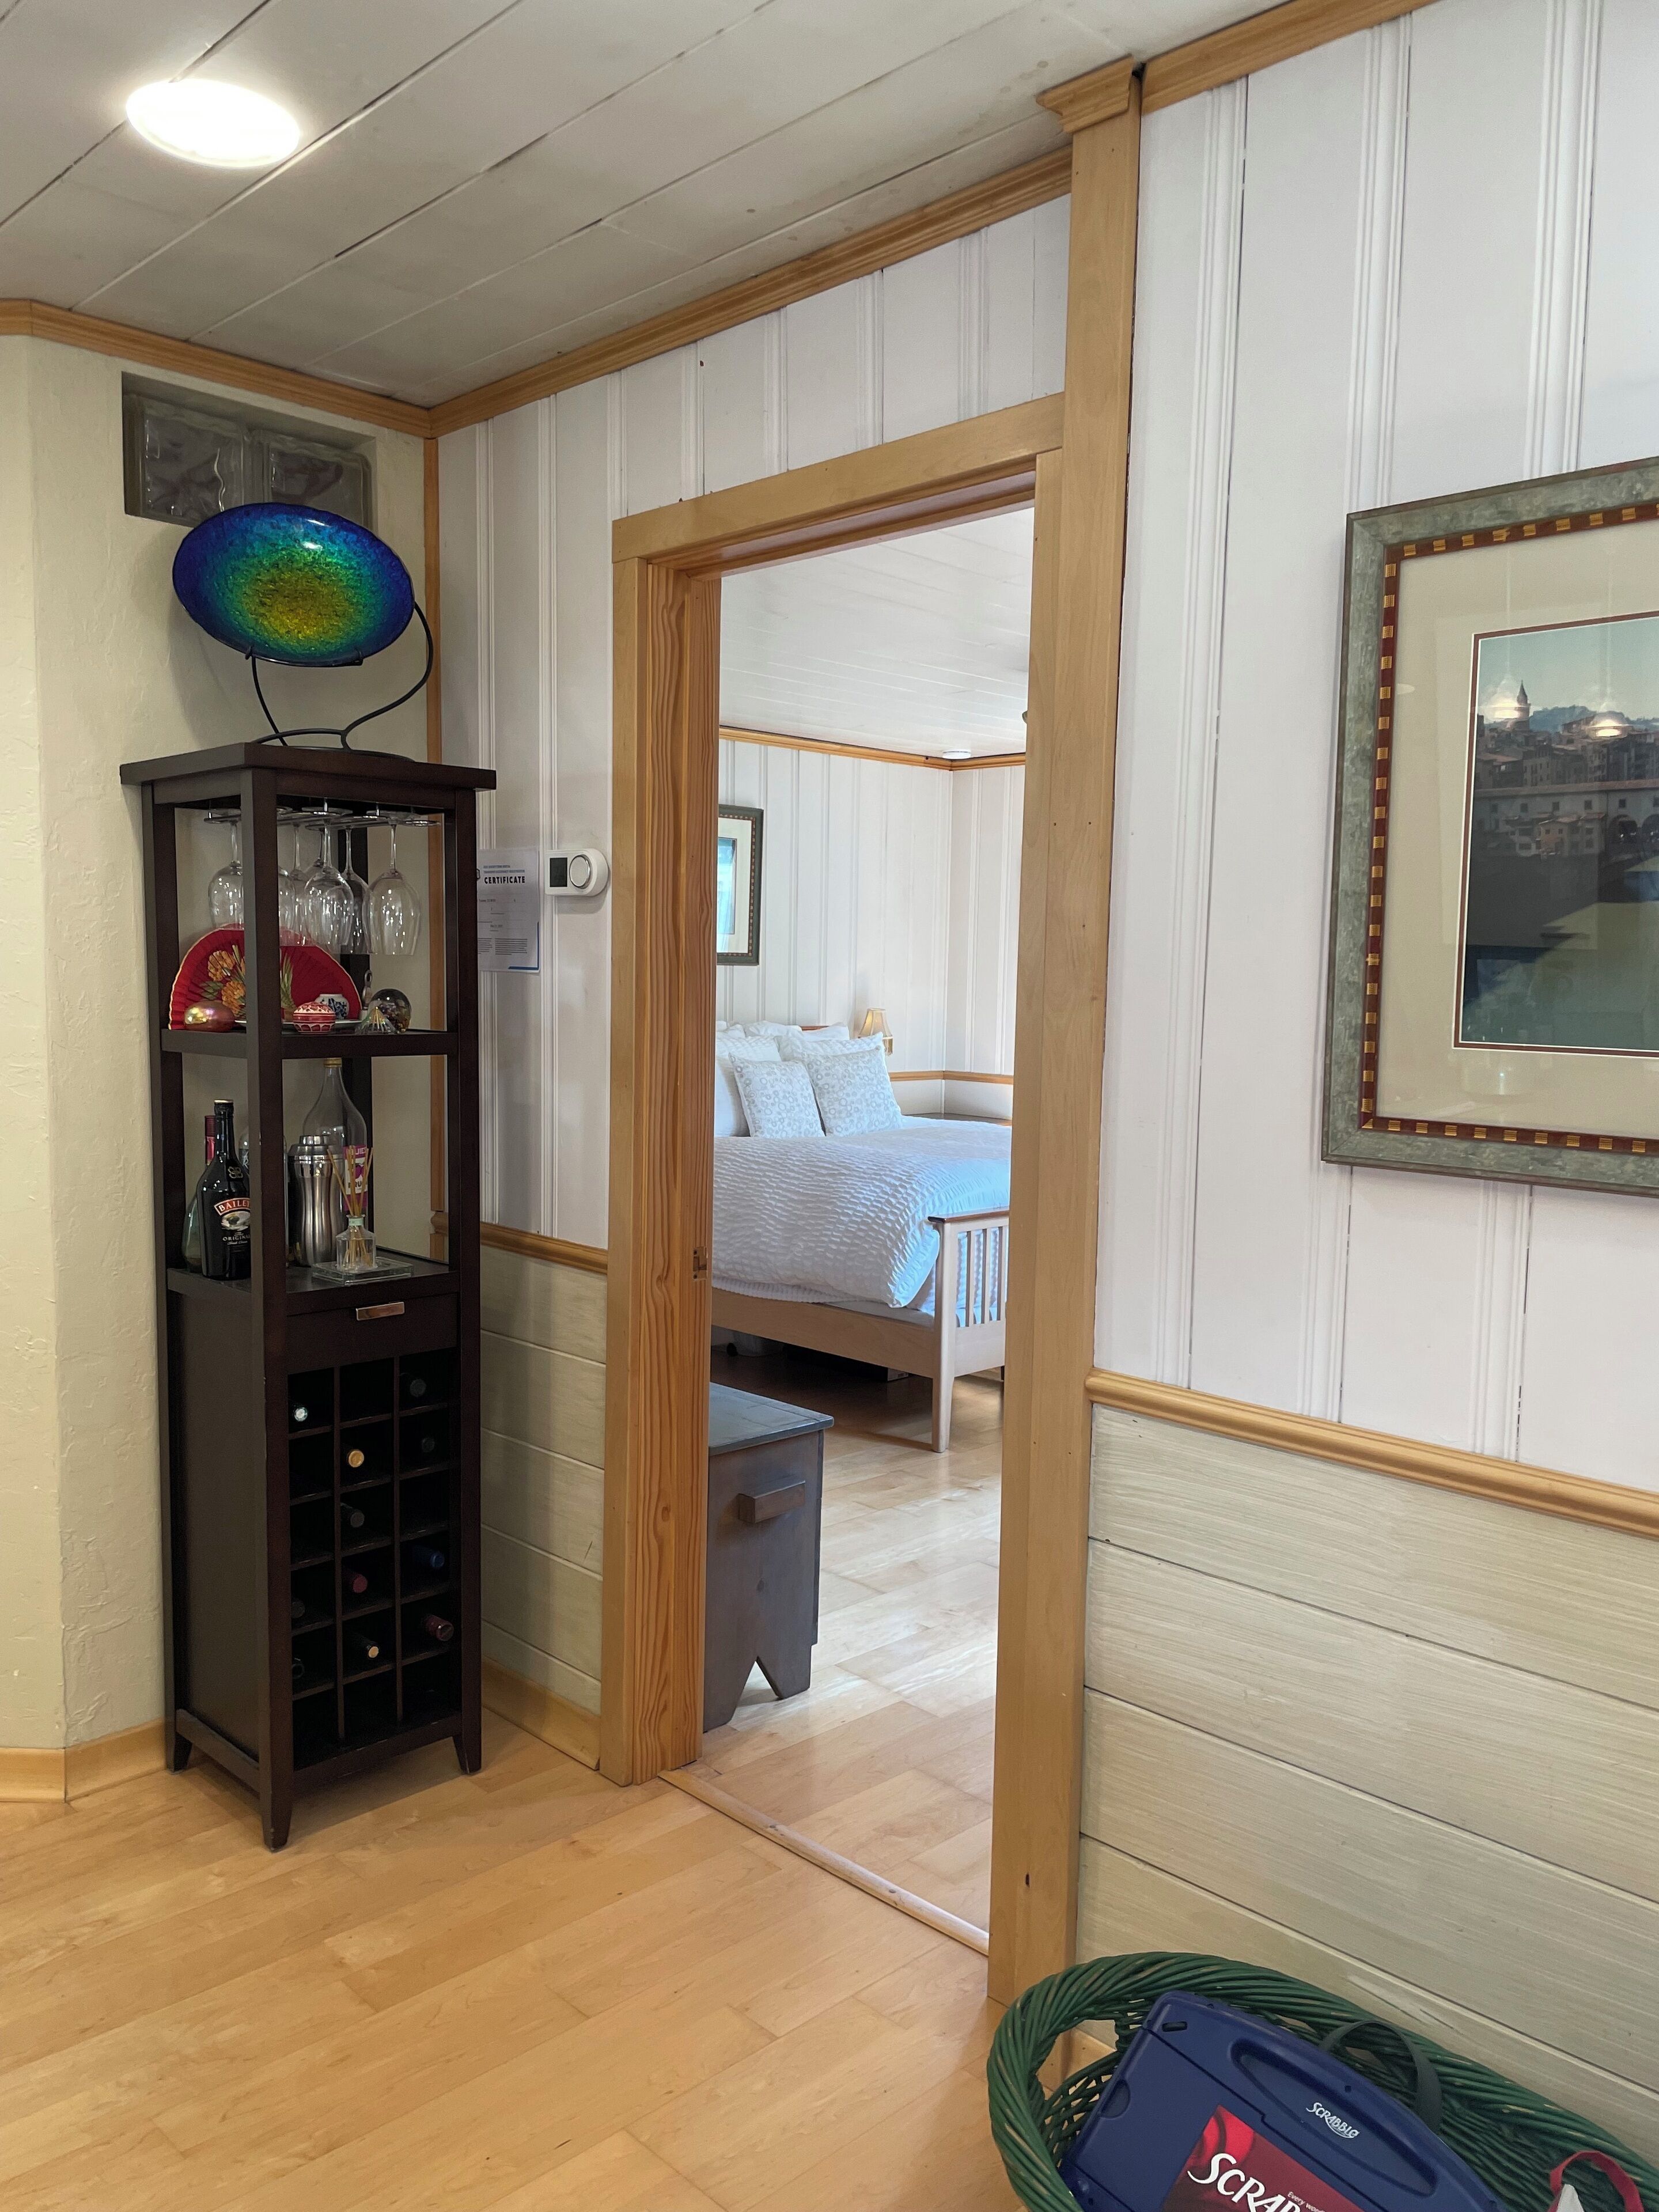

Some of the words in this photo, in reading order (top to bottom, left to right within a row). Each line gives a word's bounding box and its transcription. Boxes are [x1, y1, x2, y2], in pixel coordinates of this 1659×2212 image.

[484, 876, 525, 884] CERTIFICATE
[1306, 2102, 1360, 2138] SCRABBLE
[1287, 2191, 1305, 2206] Every
